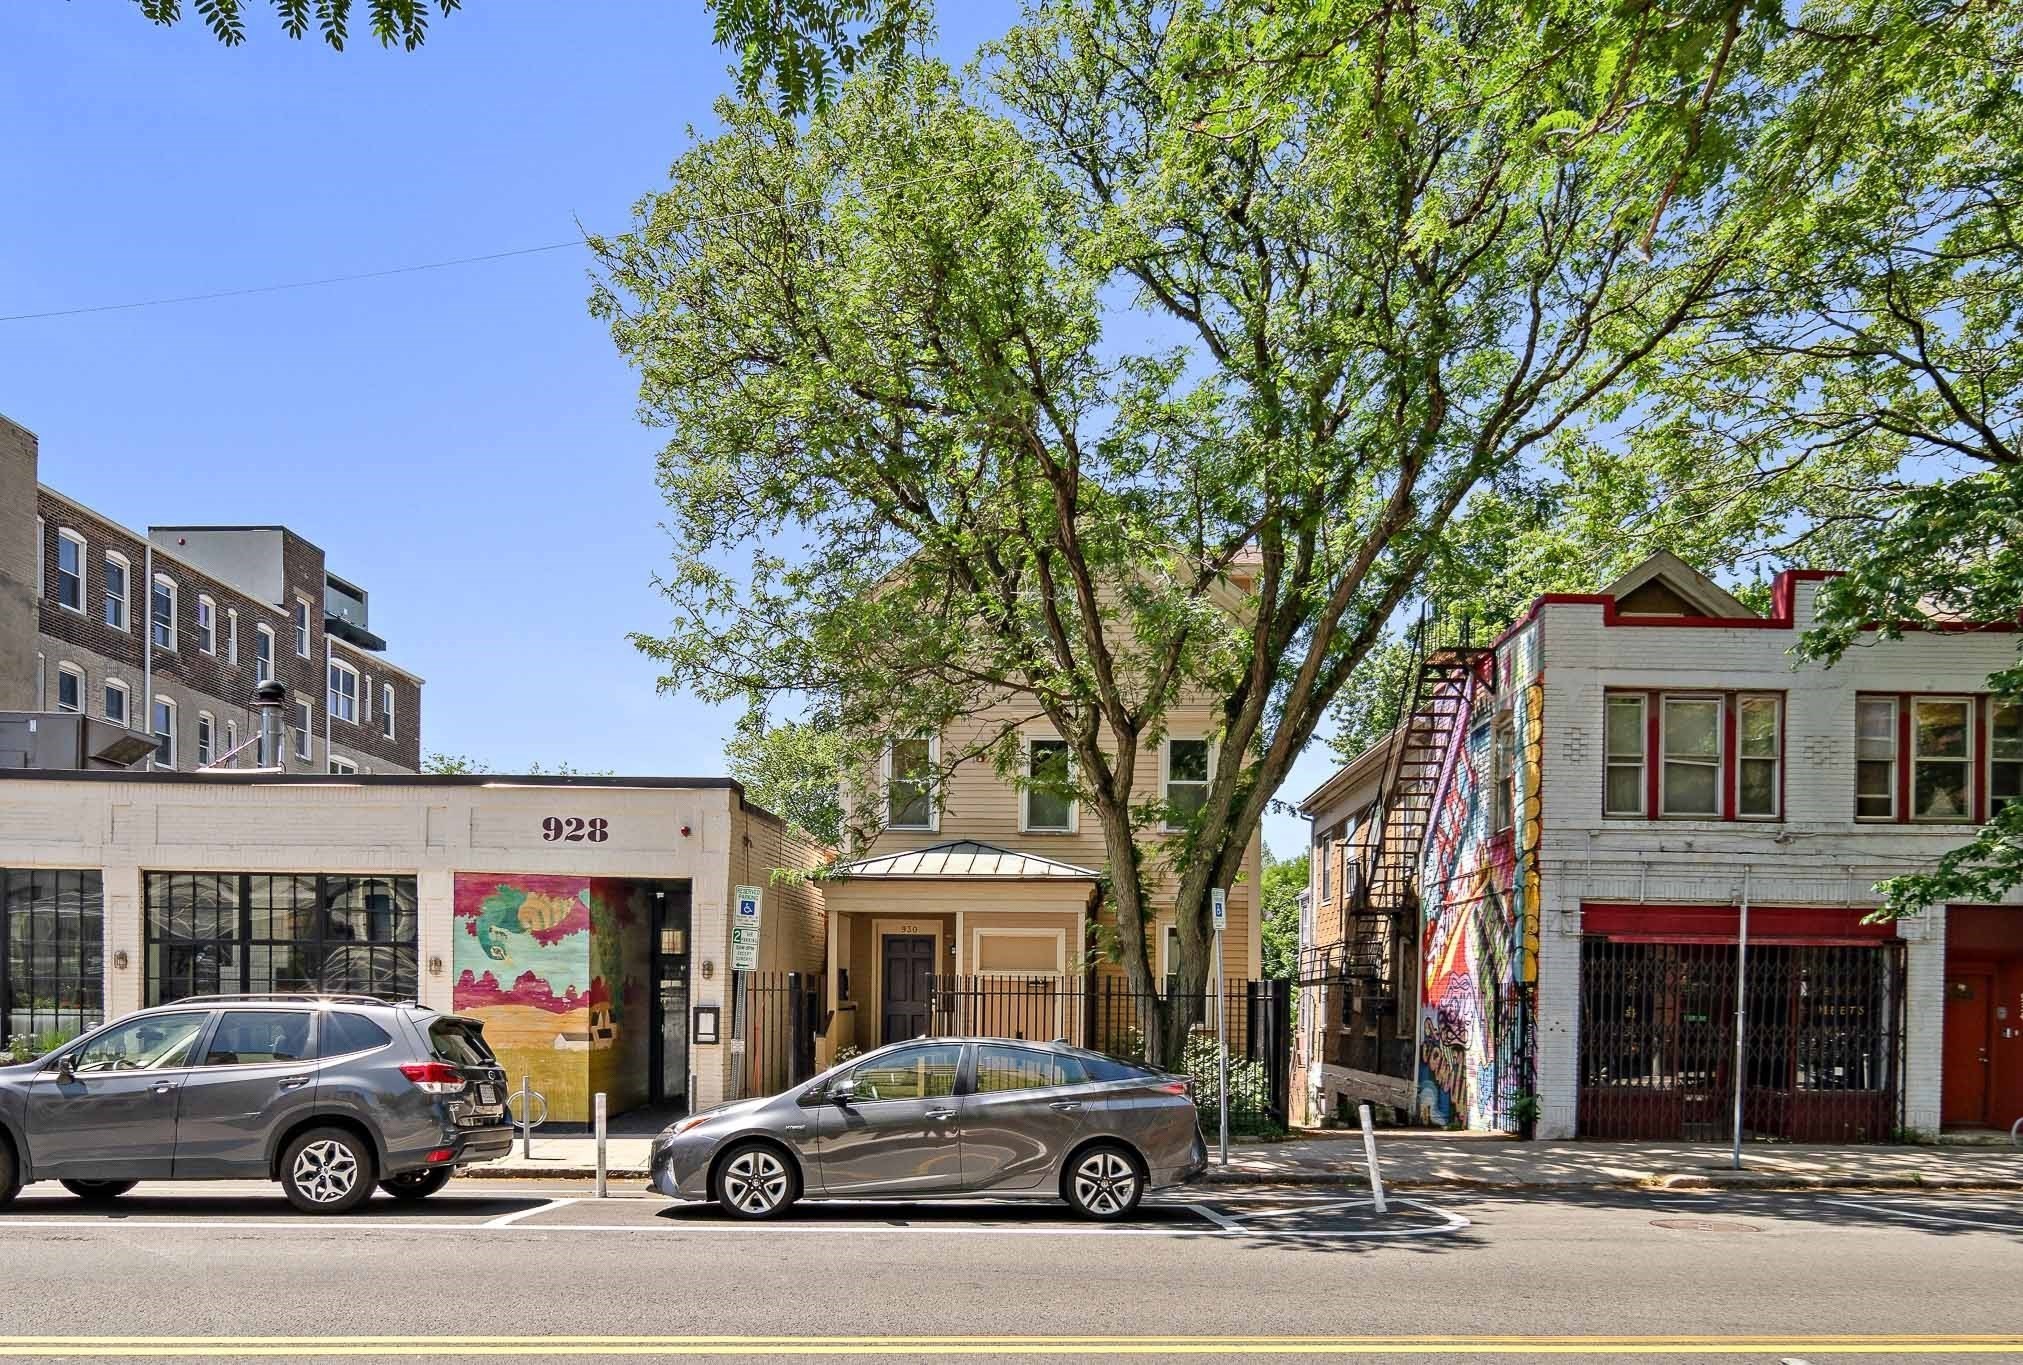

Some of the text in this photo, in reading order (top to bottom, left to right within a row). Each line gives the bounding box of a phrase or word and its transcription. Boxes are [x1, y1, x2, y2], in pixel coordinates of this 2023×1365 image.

[542, 816, 609, 843] 928
[900, 925, 918, 933] 930
[734, 930, 741, 942] 2
